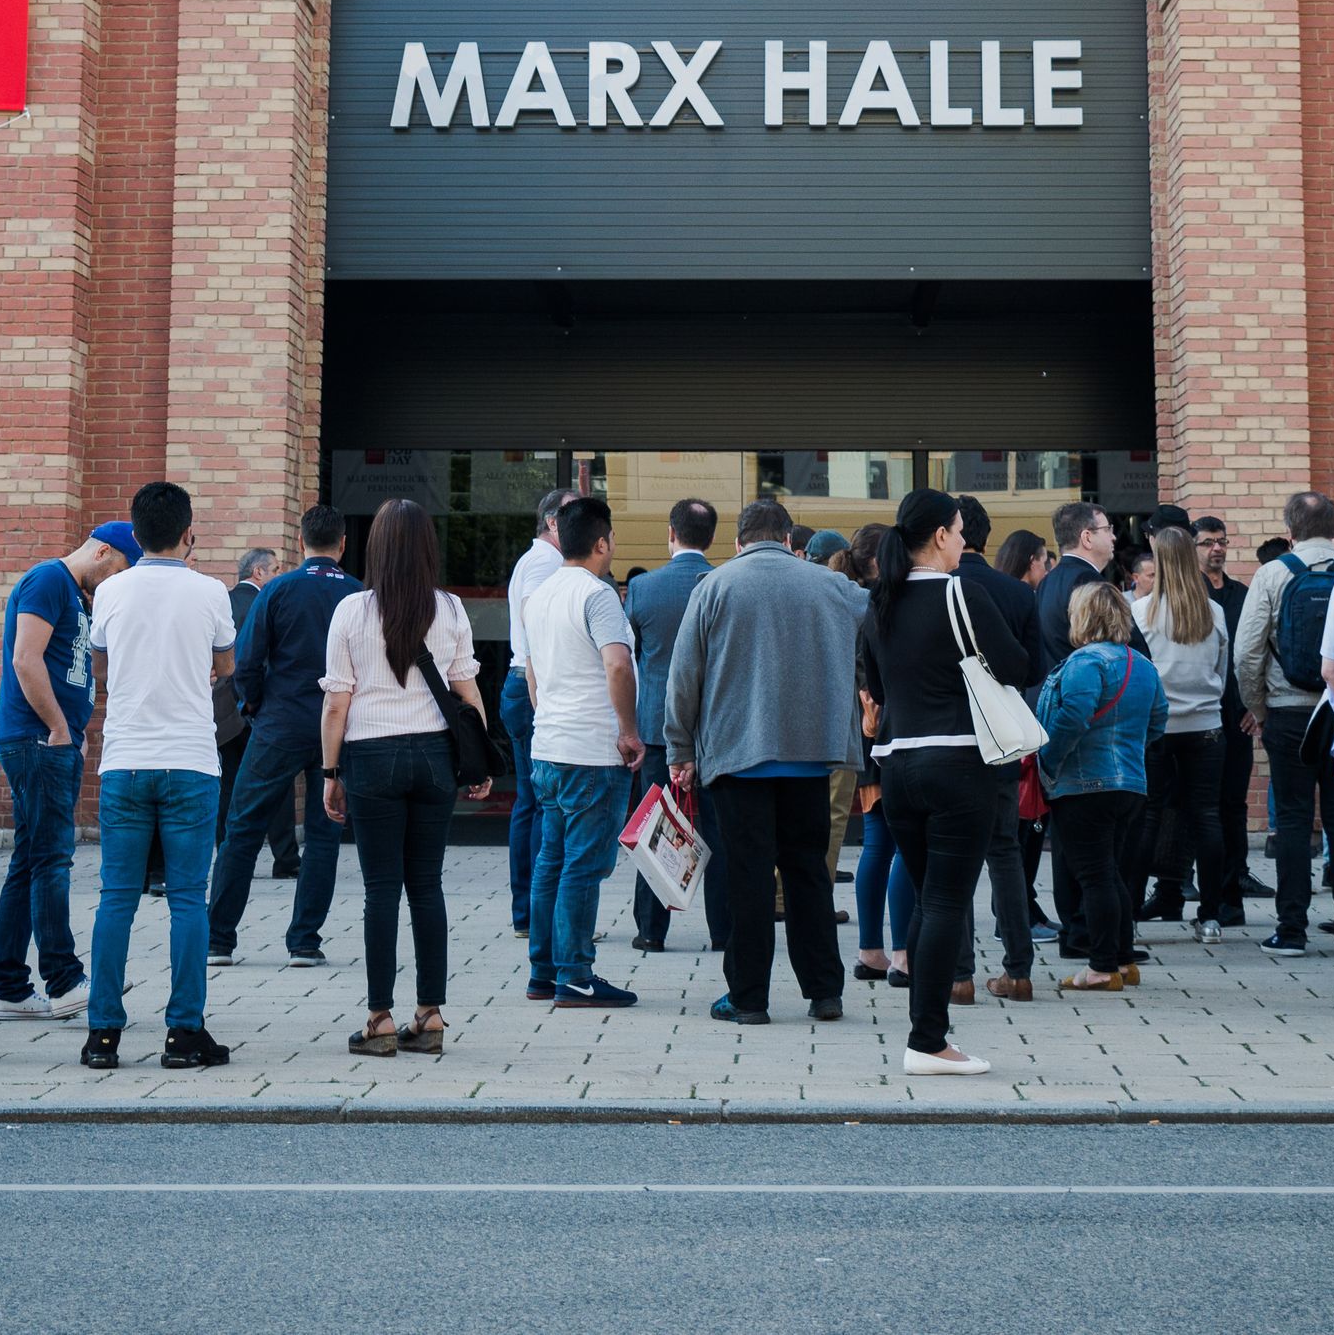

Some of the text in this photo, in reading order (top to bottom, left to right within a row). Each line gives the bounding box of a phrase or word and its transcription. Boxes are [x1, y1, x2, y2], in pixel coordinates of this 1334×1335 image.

[389, 39, 1084, 129] MARX HALLE
[386, 456, 412, 465] DAY
